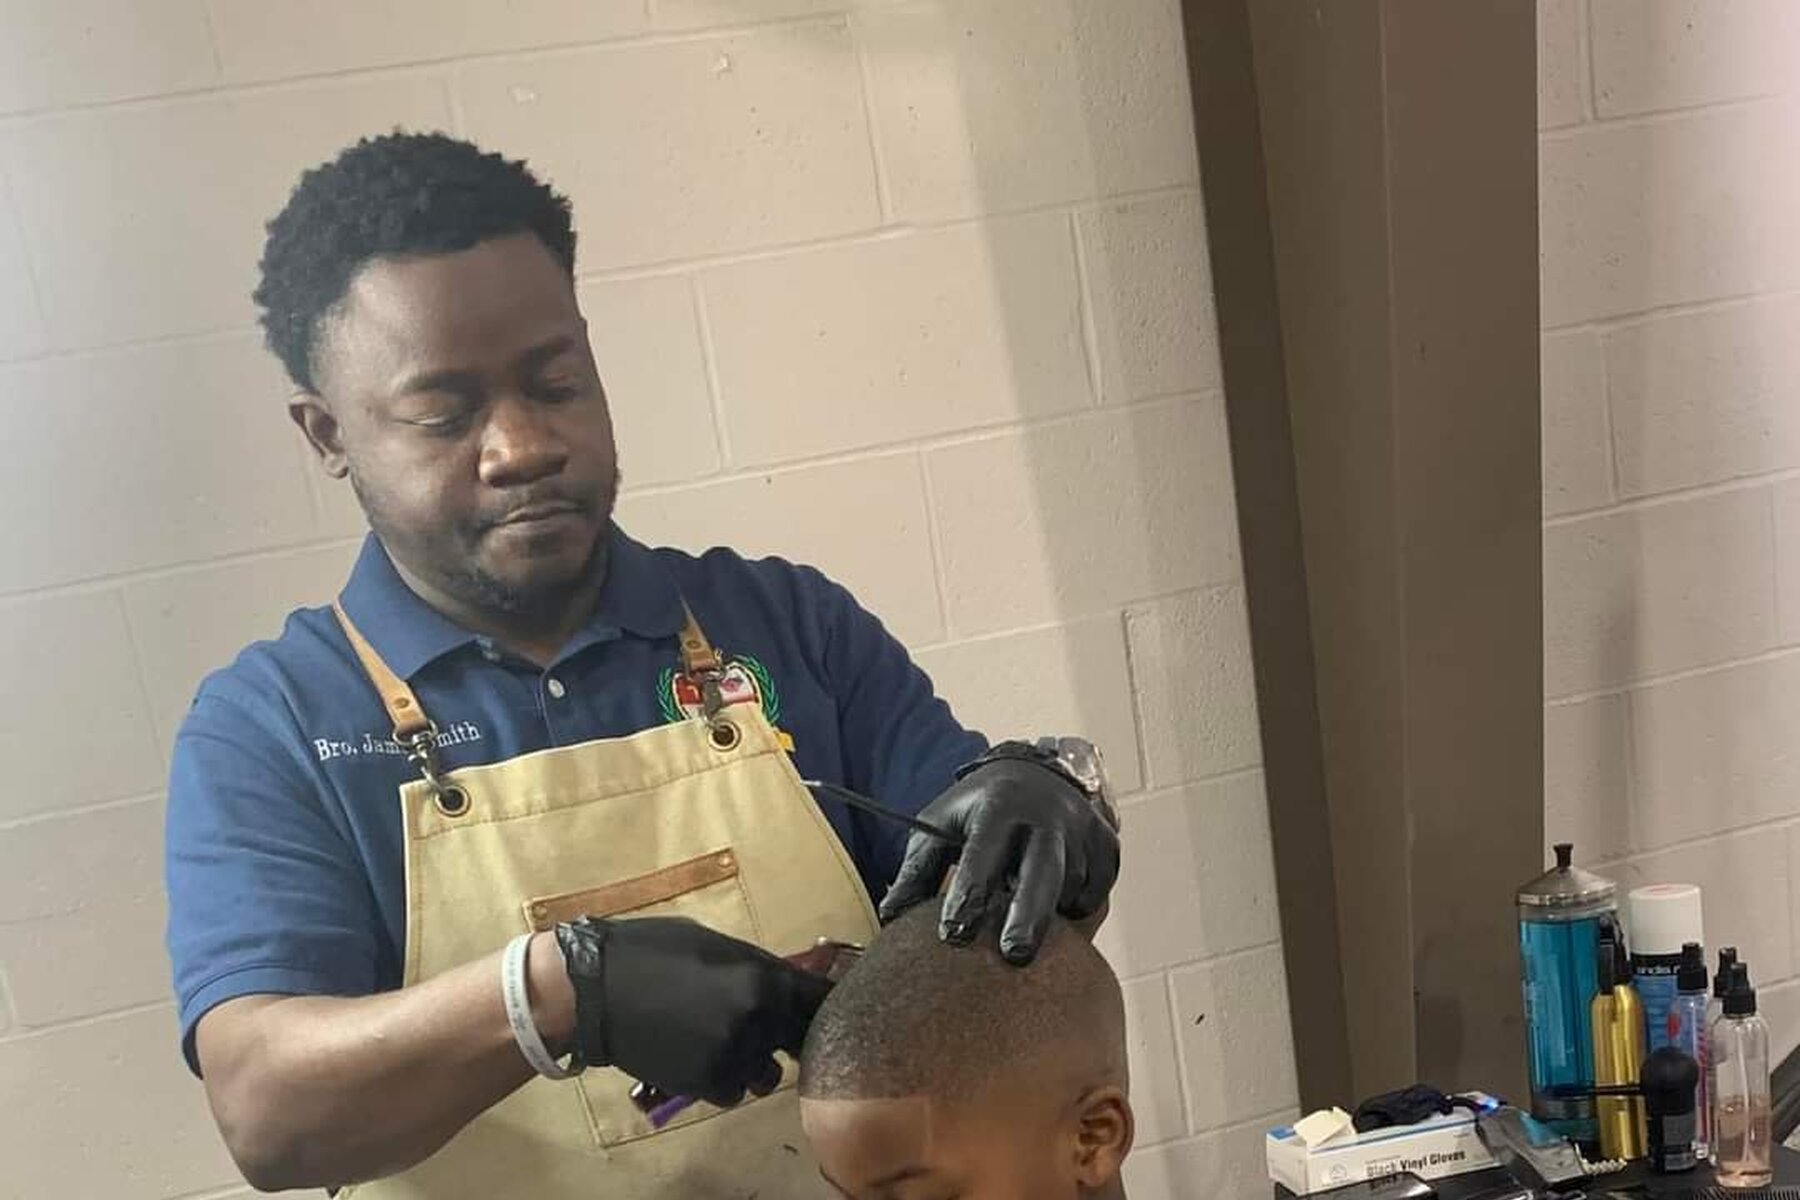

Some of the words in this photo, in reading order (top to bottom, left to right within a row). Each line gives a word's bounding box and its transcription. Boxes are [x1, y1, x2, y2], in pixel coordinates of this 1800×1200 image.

[314, 737, 358, 761] Bro.
[363, 733, 410, 756] Jam
[430, 720, 481, 748] mith
[1400, 1155, 1429, 1171] Vinyl
[1430, 1150, 1467, 1165] Gloves
